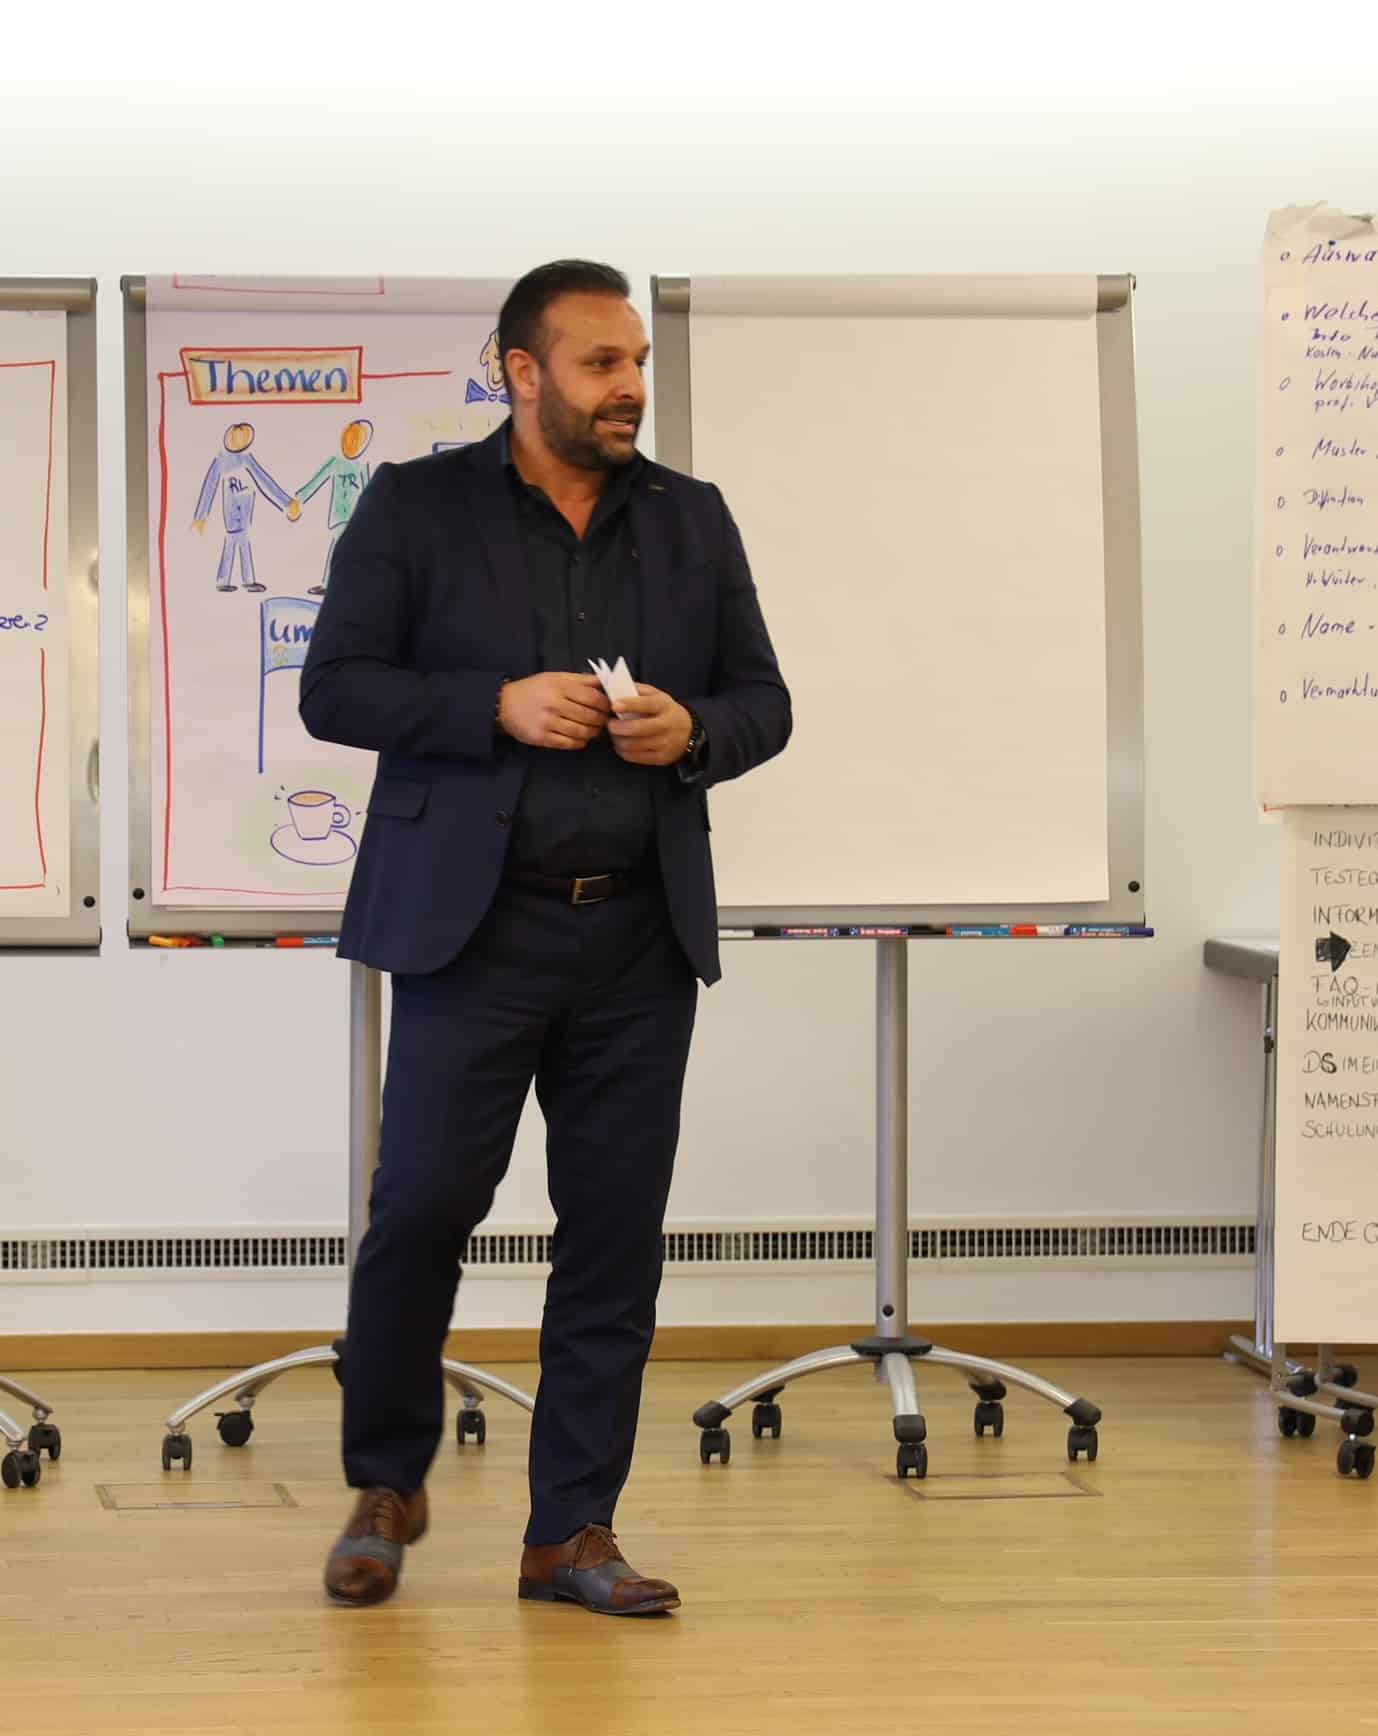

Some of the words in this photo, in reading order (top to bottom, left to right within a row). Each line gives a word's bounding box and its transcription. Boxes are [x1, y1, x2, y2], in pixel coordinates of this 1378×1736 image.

[189, 357, 349, 395] Themen
[229, 477, 248, 493] RL
[338, 473, 360, 490] TR
[1301, 612, 1356, 640] Name
[1301, 1119, 1378, 1139] SCHULUN
[1302, 1220, 1358, 1243] ENDE
